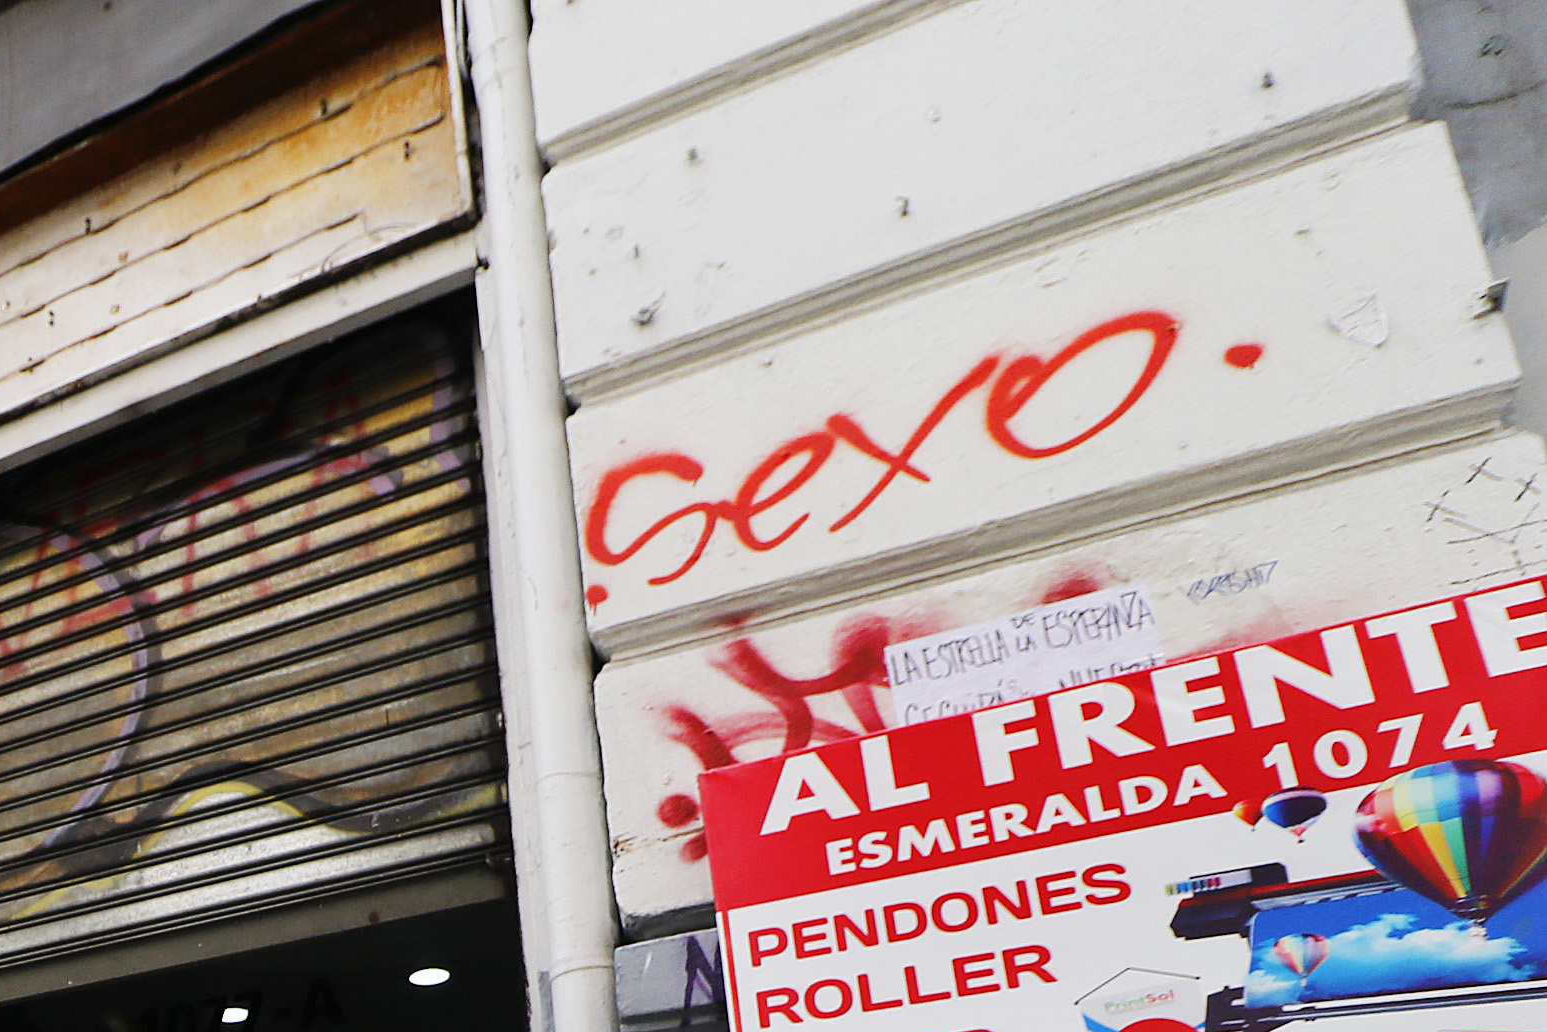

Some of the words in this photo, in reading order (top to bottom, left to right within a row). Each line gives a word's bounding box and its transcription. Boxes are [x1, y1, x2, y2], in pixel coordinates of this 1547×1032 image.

[889, 653, 919, 687] LA
[923, 629, 1010, 681] ESTRELLA
[1043, 590, 1156, 650] ESPERANZA
[761, 736, 929, 836] AL
[972, 581, 1547, 787] FRENTE
[825, 764, 1227, 876] ESMERALDA
[1264, 702, 1498, 789] 1074
[748, 863, 1132, 967] PENDONES
[756, 945, 1058, 1029] ROLLER
